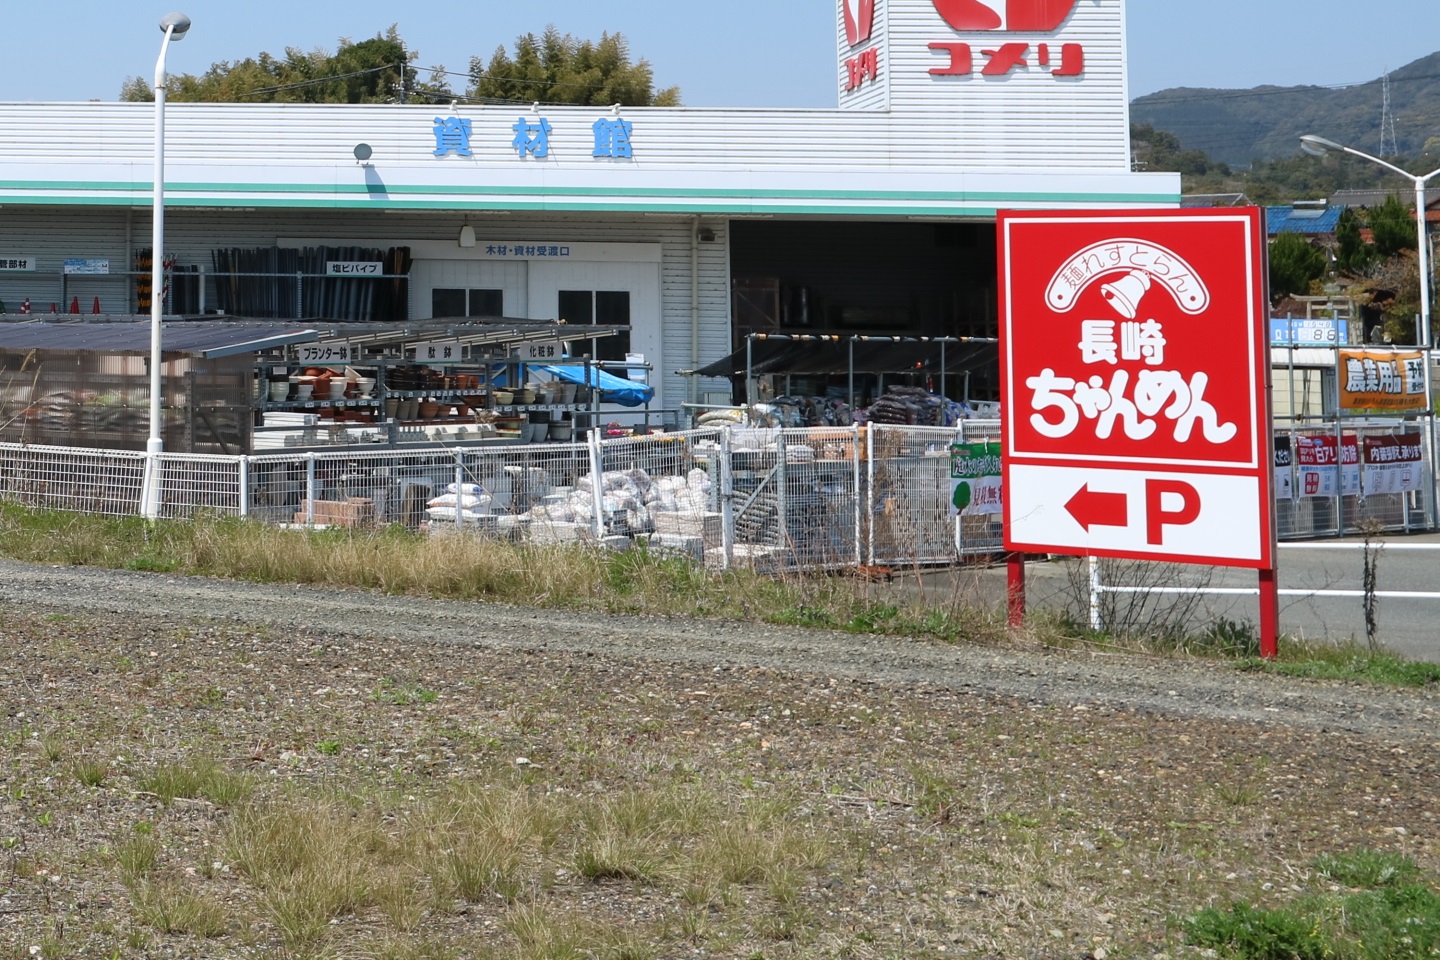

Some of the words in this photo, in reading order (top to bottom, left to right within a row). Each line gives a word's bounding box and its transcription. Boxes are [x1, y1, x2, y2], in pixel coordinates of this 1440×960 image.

[844, 46, 877, 90] コメリ
[927, 42, 1084, 76] コメリ
[432, 116, 633, 158] 資材館
[485, 244, 571, 257] 木材・資材受渡口
[303, 346, 348, 361] プランター鉢
[528, 344, 555, 357] 化粧鉢
[1077, 318, 1167, 366] 長崎
[1025, 367, 1238, 444] ちゃんめん
[1145, 478, 1202, 546] P
